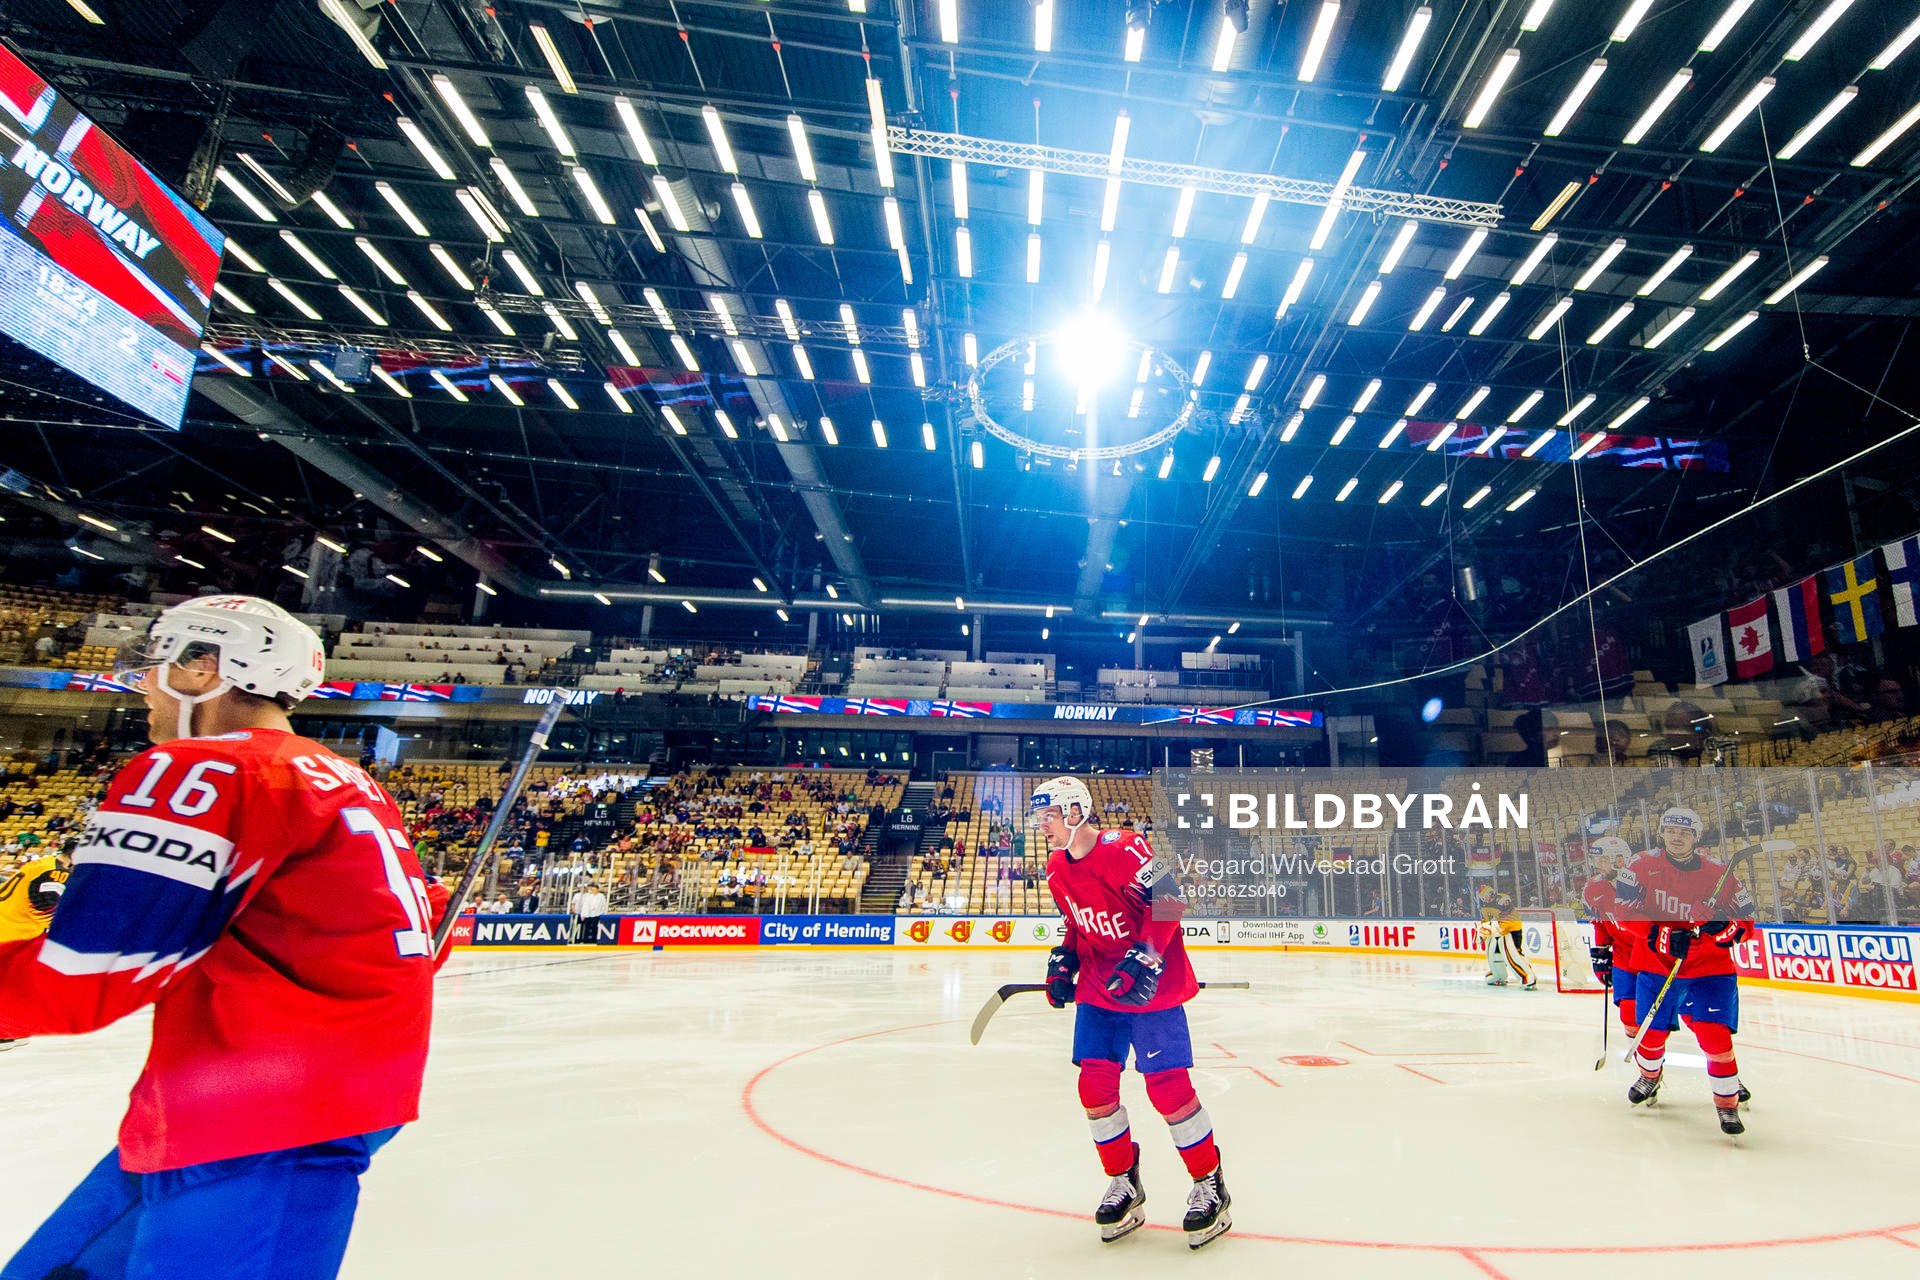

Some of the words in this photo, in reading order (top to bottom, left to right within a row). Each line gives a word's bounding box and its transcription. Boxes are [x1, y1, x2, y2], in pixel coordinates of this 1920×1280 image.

[12, 140, 162, 260] NORWAY
[117, 327, 139, 355] 2
[187, 624, 229, 636] CCM
[1054, 705, 1117, 721] NORWAY
[120, 751, 238, 818] 16
[594, 809, 608, 819] L5
[901, 814, 913, 823] L6
[50, 870, 70, 883] 40
[1655, 889, 1694, 923] NOR
[476, 922, 551, 941] NIVEA
[556, 923, 616, 940] MN
[659, 925, 746, 938] ROCKWOOL
[764, 922, 799, 941] City
[802, 922, 821, 938] of
[825, 922, 892, 941] Herning
[1242, 920, 1284, 929] Download
[1285, 921, 1299, 929] the
[1237, 931, 1267, 939] Official
[1269, 931, 1285, 939] IIHF
[1288, 932, 1304, 941] App
[1364, 925, 1416, 947] IIHF
[1770, 933, 1828, 957] LIQUI
[1729, 940, 1763, 970] CE
[1839, 935, 1910, 962] LIQUI
[1774, 957, 1832, 982] MOLY
[1842, 961, 1914, 989] MOLY
